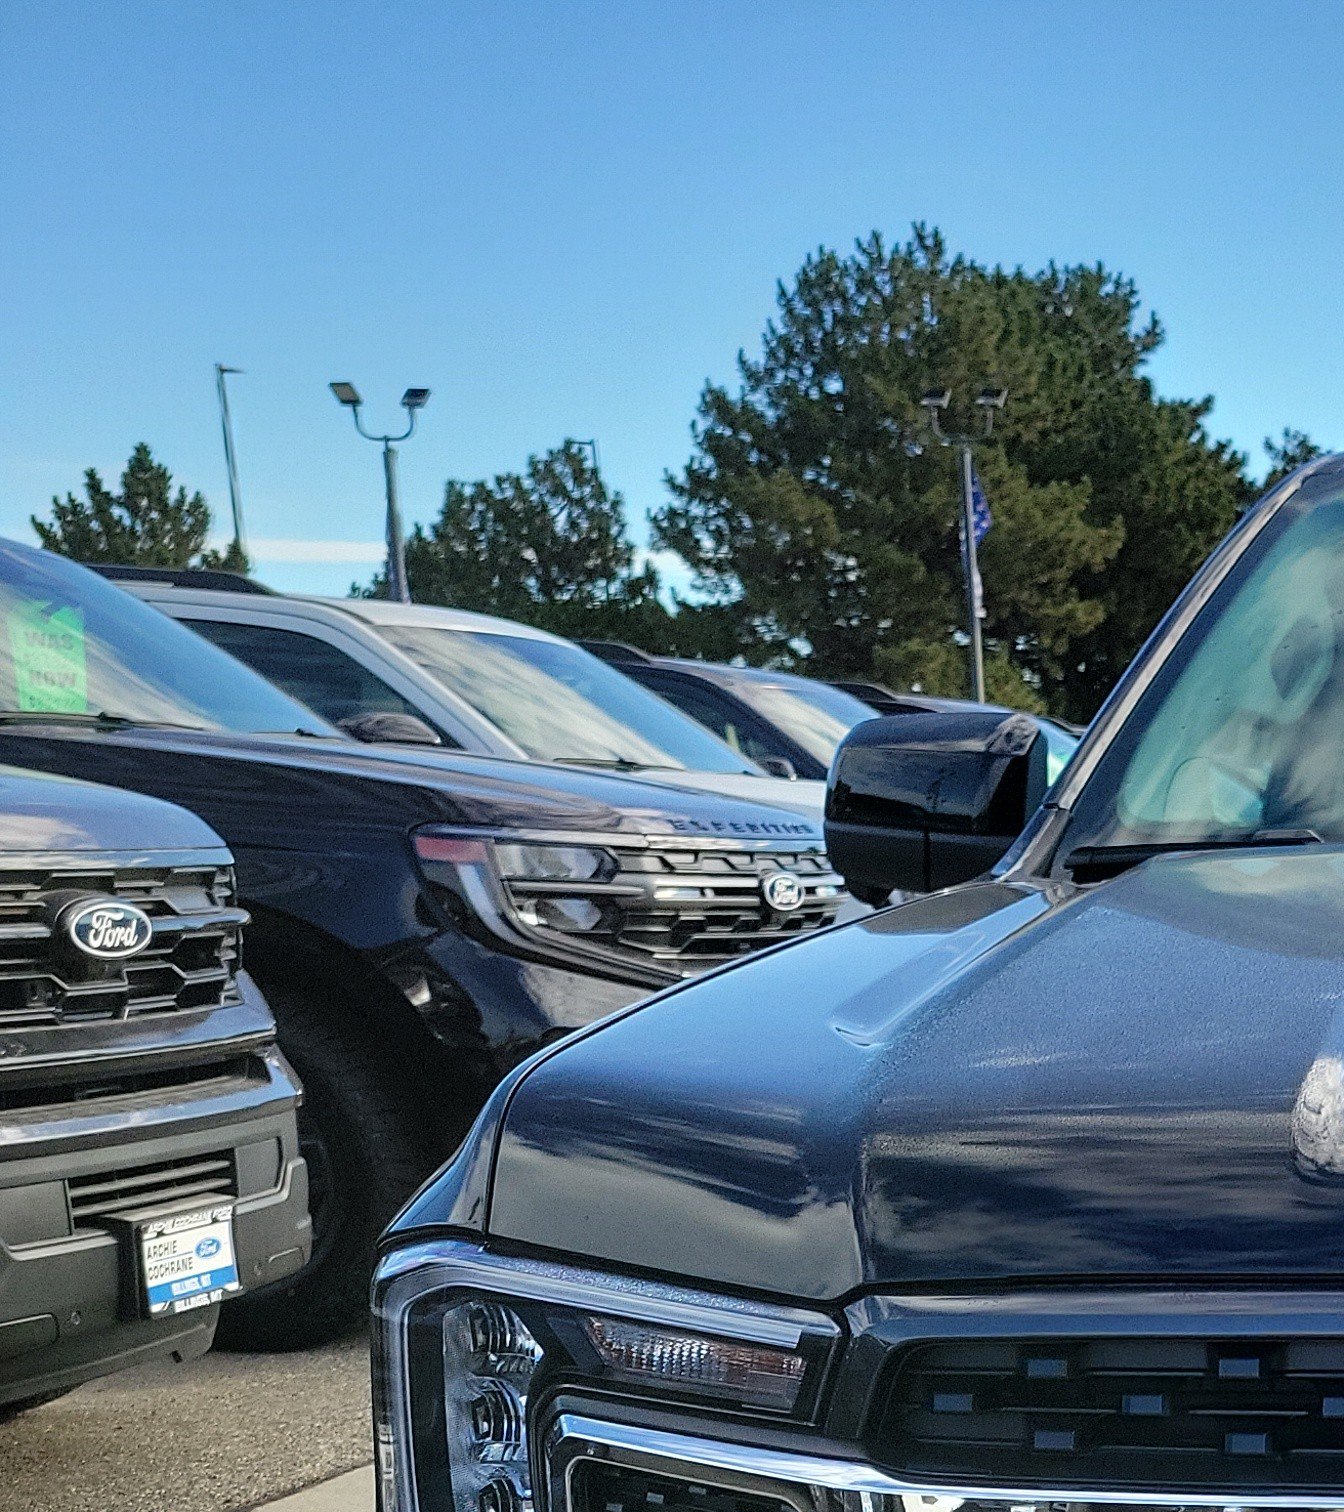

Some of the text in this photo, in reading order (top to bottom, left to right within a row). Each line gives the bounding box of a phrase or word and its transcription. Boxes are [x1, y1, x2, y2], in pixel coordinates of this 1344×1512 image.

[773, 877, 799, 904] Ford
[88, 910, 139, 949] Ford
[146, 1240, 178, 1260] ARCHIE
[148, 1256, 194, 1281] COCHRANE
